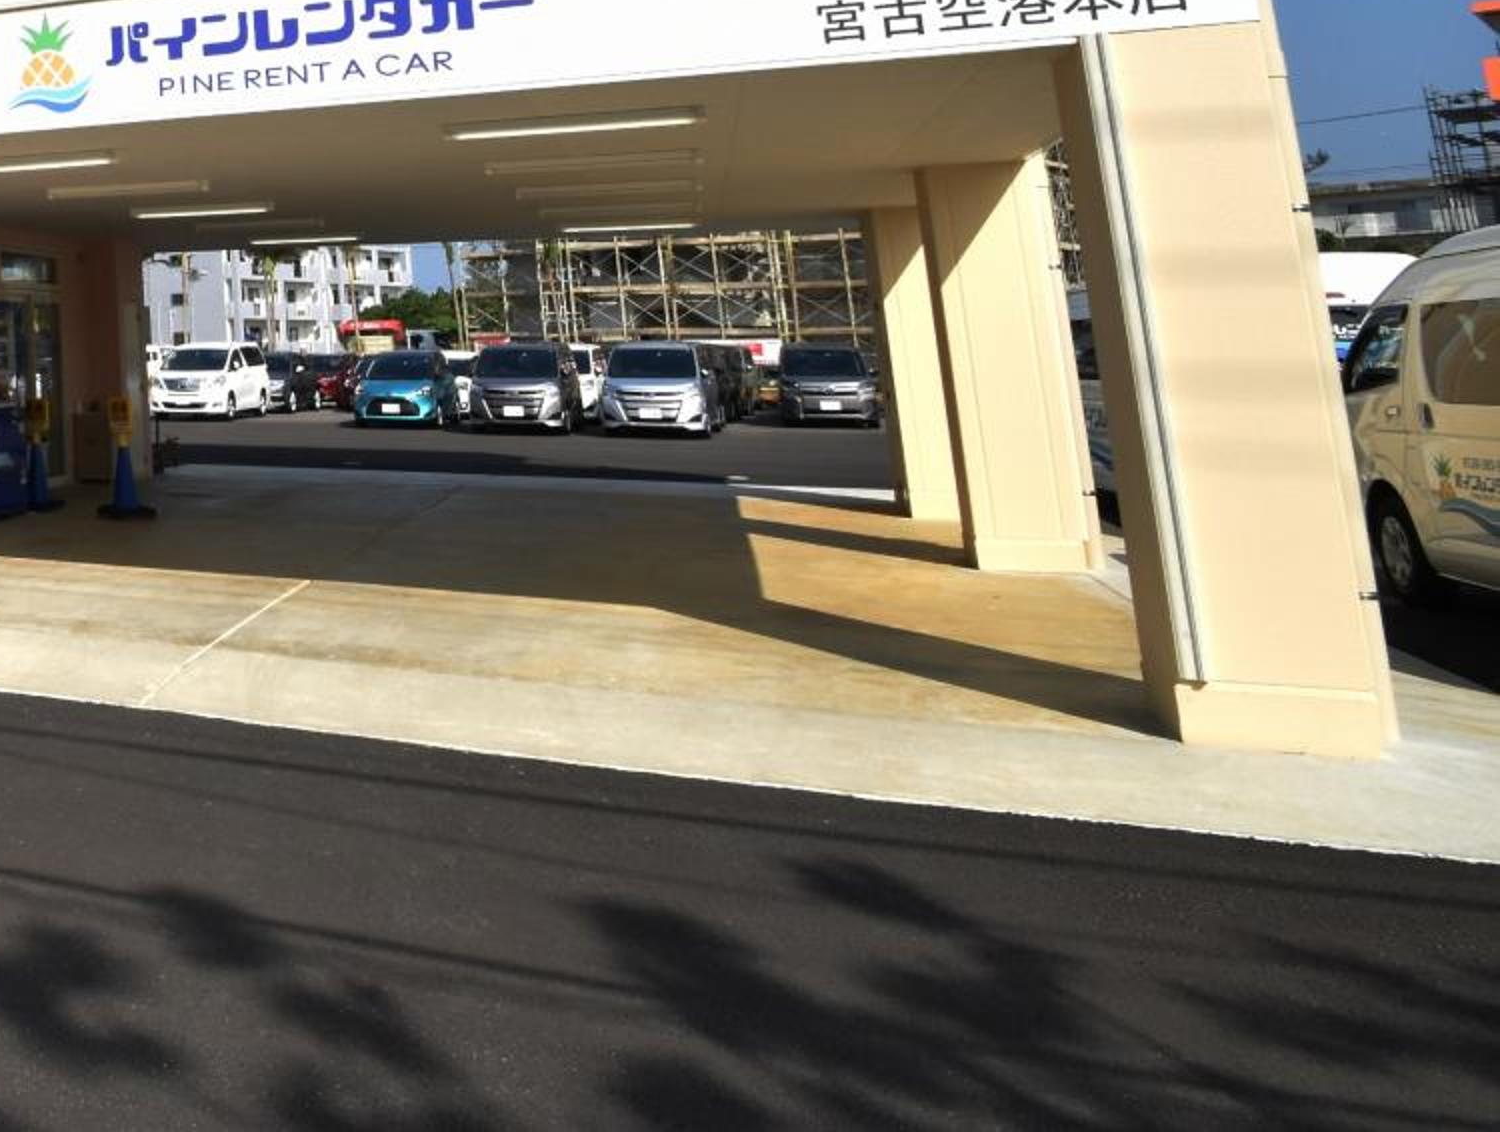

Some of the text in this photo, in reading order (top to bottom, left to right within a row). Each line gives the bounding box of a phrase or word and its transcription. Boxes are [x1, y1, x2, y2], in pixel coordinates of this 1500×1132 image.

[158, 51, 454, 97] PINE RENT A CAR
